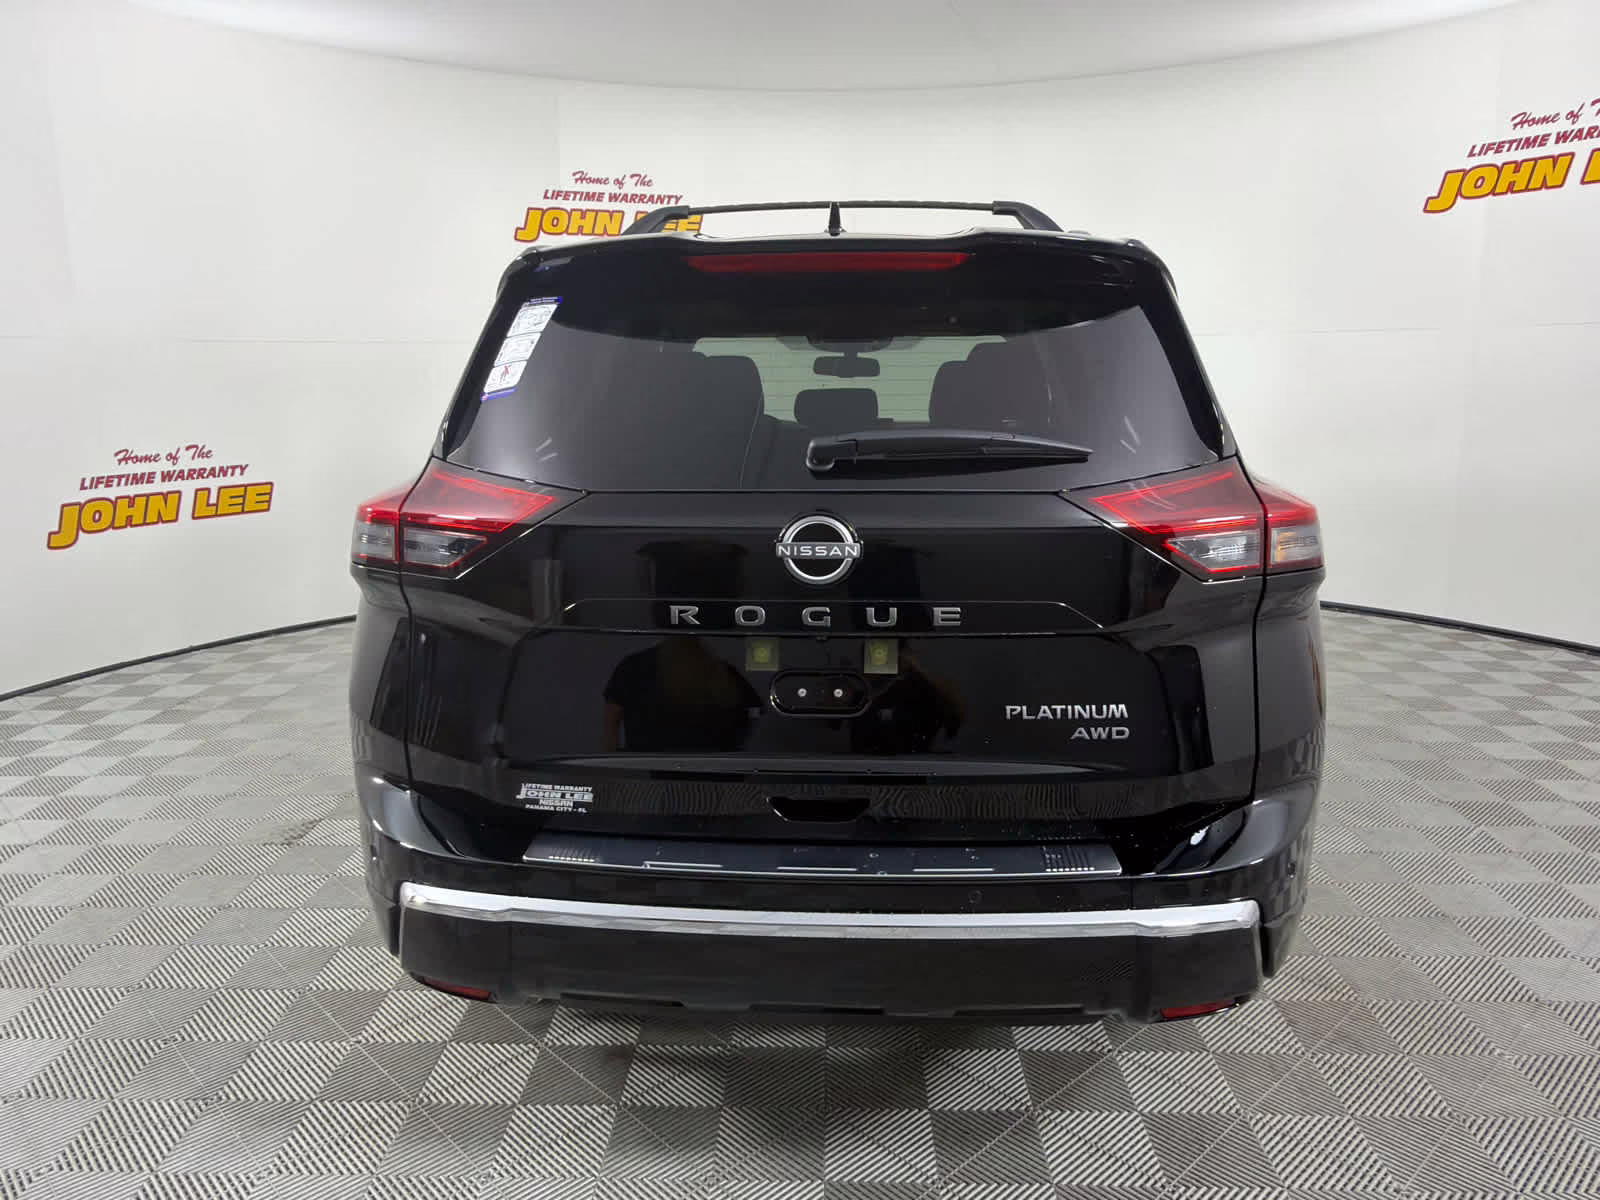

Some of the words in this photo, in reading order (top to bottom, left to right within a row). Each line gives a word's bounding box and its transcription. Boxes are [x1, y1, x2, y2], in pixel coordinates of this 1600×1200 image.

[1511, 111, 1561, 130] Home
[1565, 103, 1585, 124] of
[1467, 133, 1552, 158] LIFETIME
[572, 170, 610, 185] Home
[613, 174, 625, 189] of
[630, 174, 653, 187] The
[1423, 151, 1575, 213] JOHN
[543, 189, 604, 202] LIFETIME
[607, 192, 683, 205] WARRANTY
[514, 207, 625, 243] JOHN
[114, 448, 161, 465] Home
[165, 448, 181, 465] of
[185, 444, 213, 460] The
[79, 471, 156, 491] LIFETIME
[160, 464, 249, 483] WARRANTY
[47, 490, 182, 550] JOHN
[192, 482, 274, 520] LEE
[778, 544, 860, 557] NISSAN
[669, 605, 962, 628] ROGUE
[1005, 703, 1129, 720] PLATINUM
[1070, 726, 1130, 740] AWD
